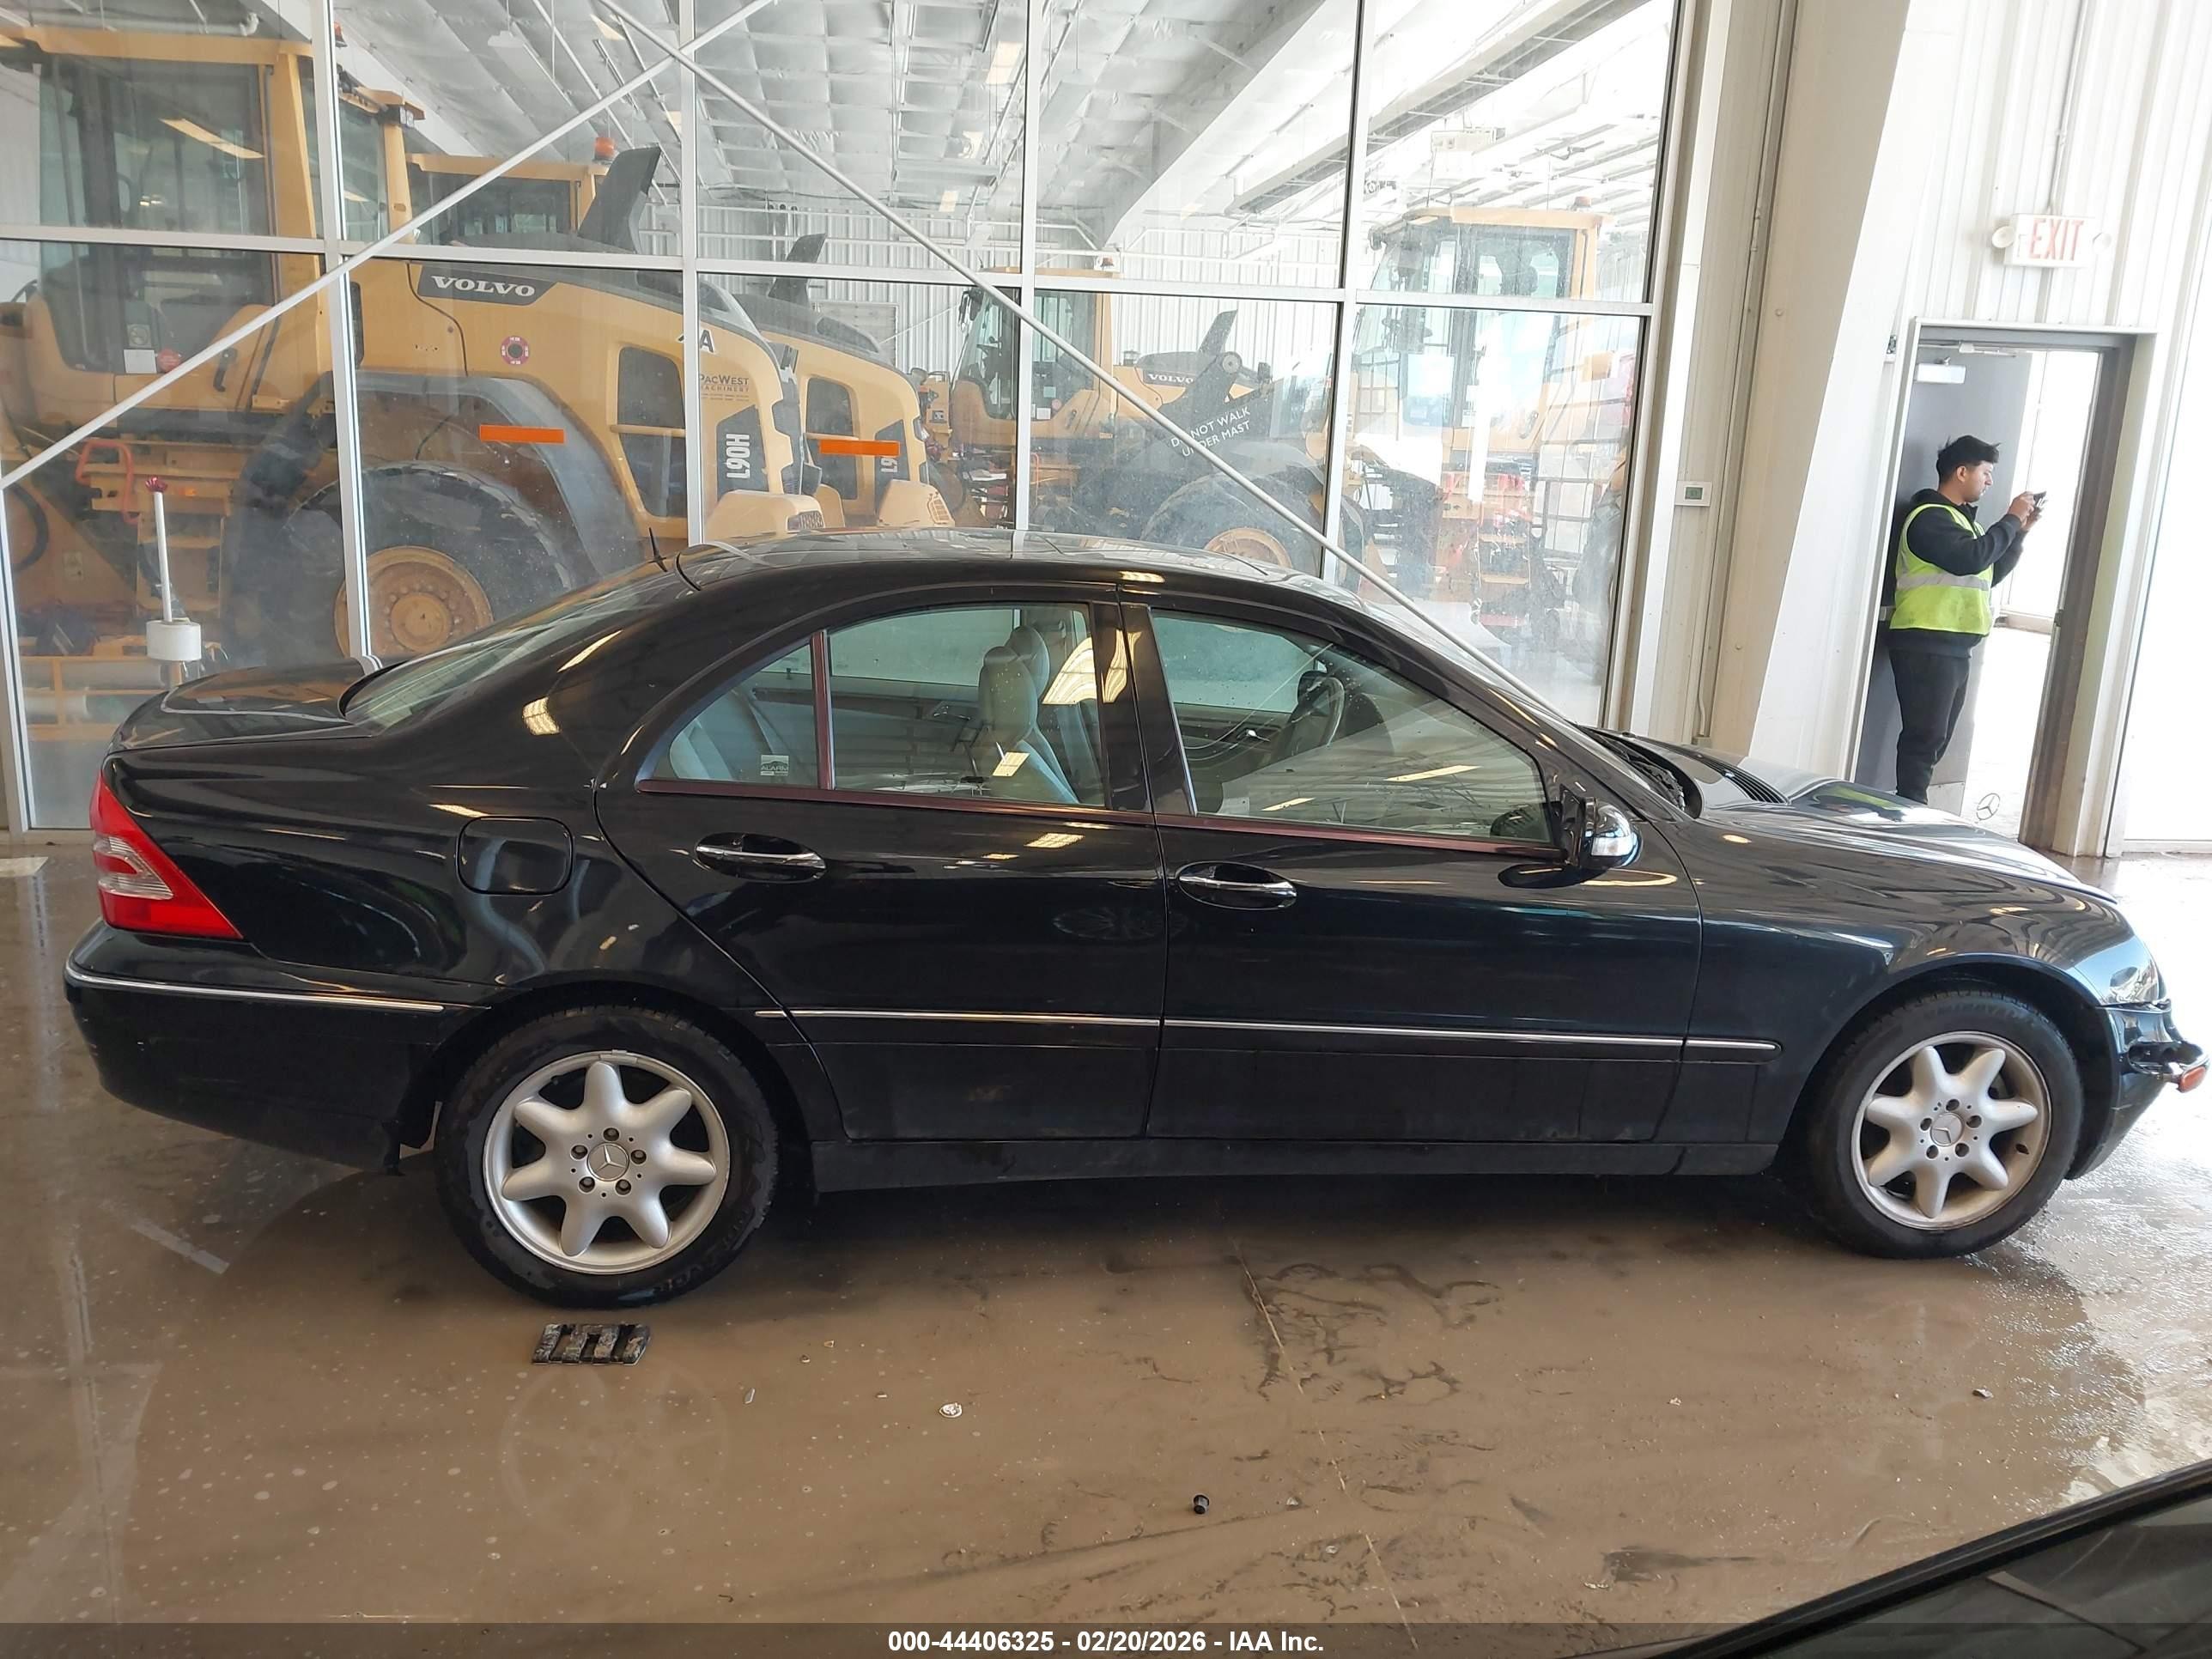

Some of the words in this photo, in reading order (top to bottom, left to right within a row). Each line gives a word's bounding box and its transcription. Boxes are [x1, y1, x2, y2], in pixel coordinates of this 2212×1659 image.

[2029, 217, 2085, 261] EXIT
[431, 276, 536, 297] VOLVO
[1148, 374, 1194, 384] VOLVO
[1190, 421, 1214, 439] NOT
[1217, 407, 1251, 427] WALK
[1221, 421, 1250, 441] MAST
[726, 433, 750, 478] L90H
